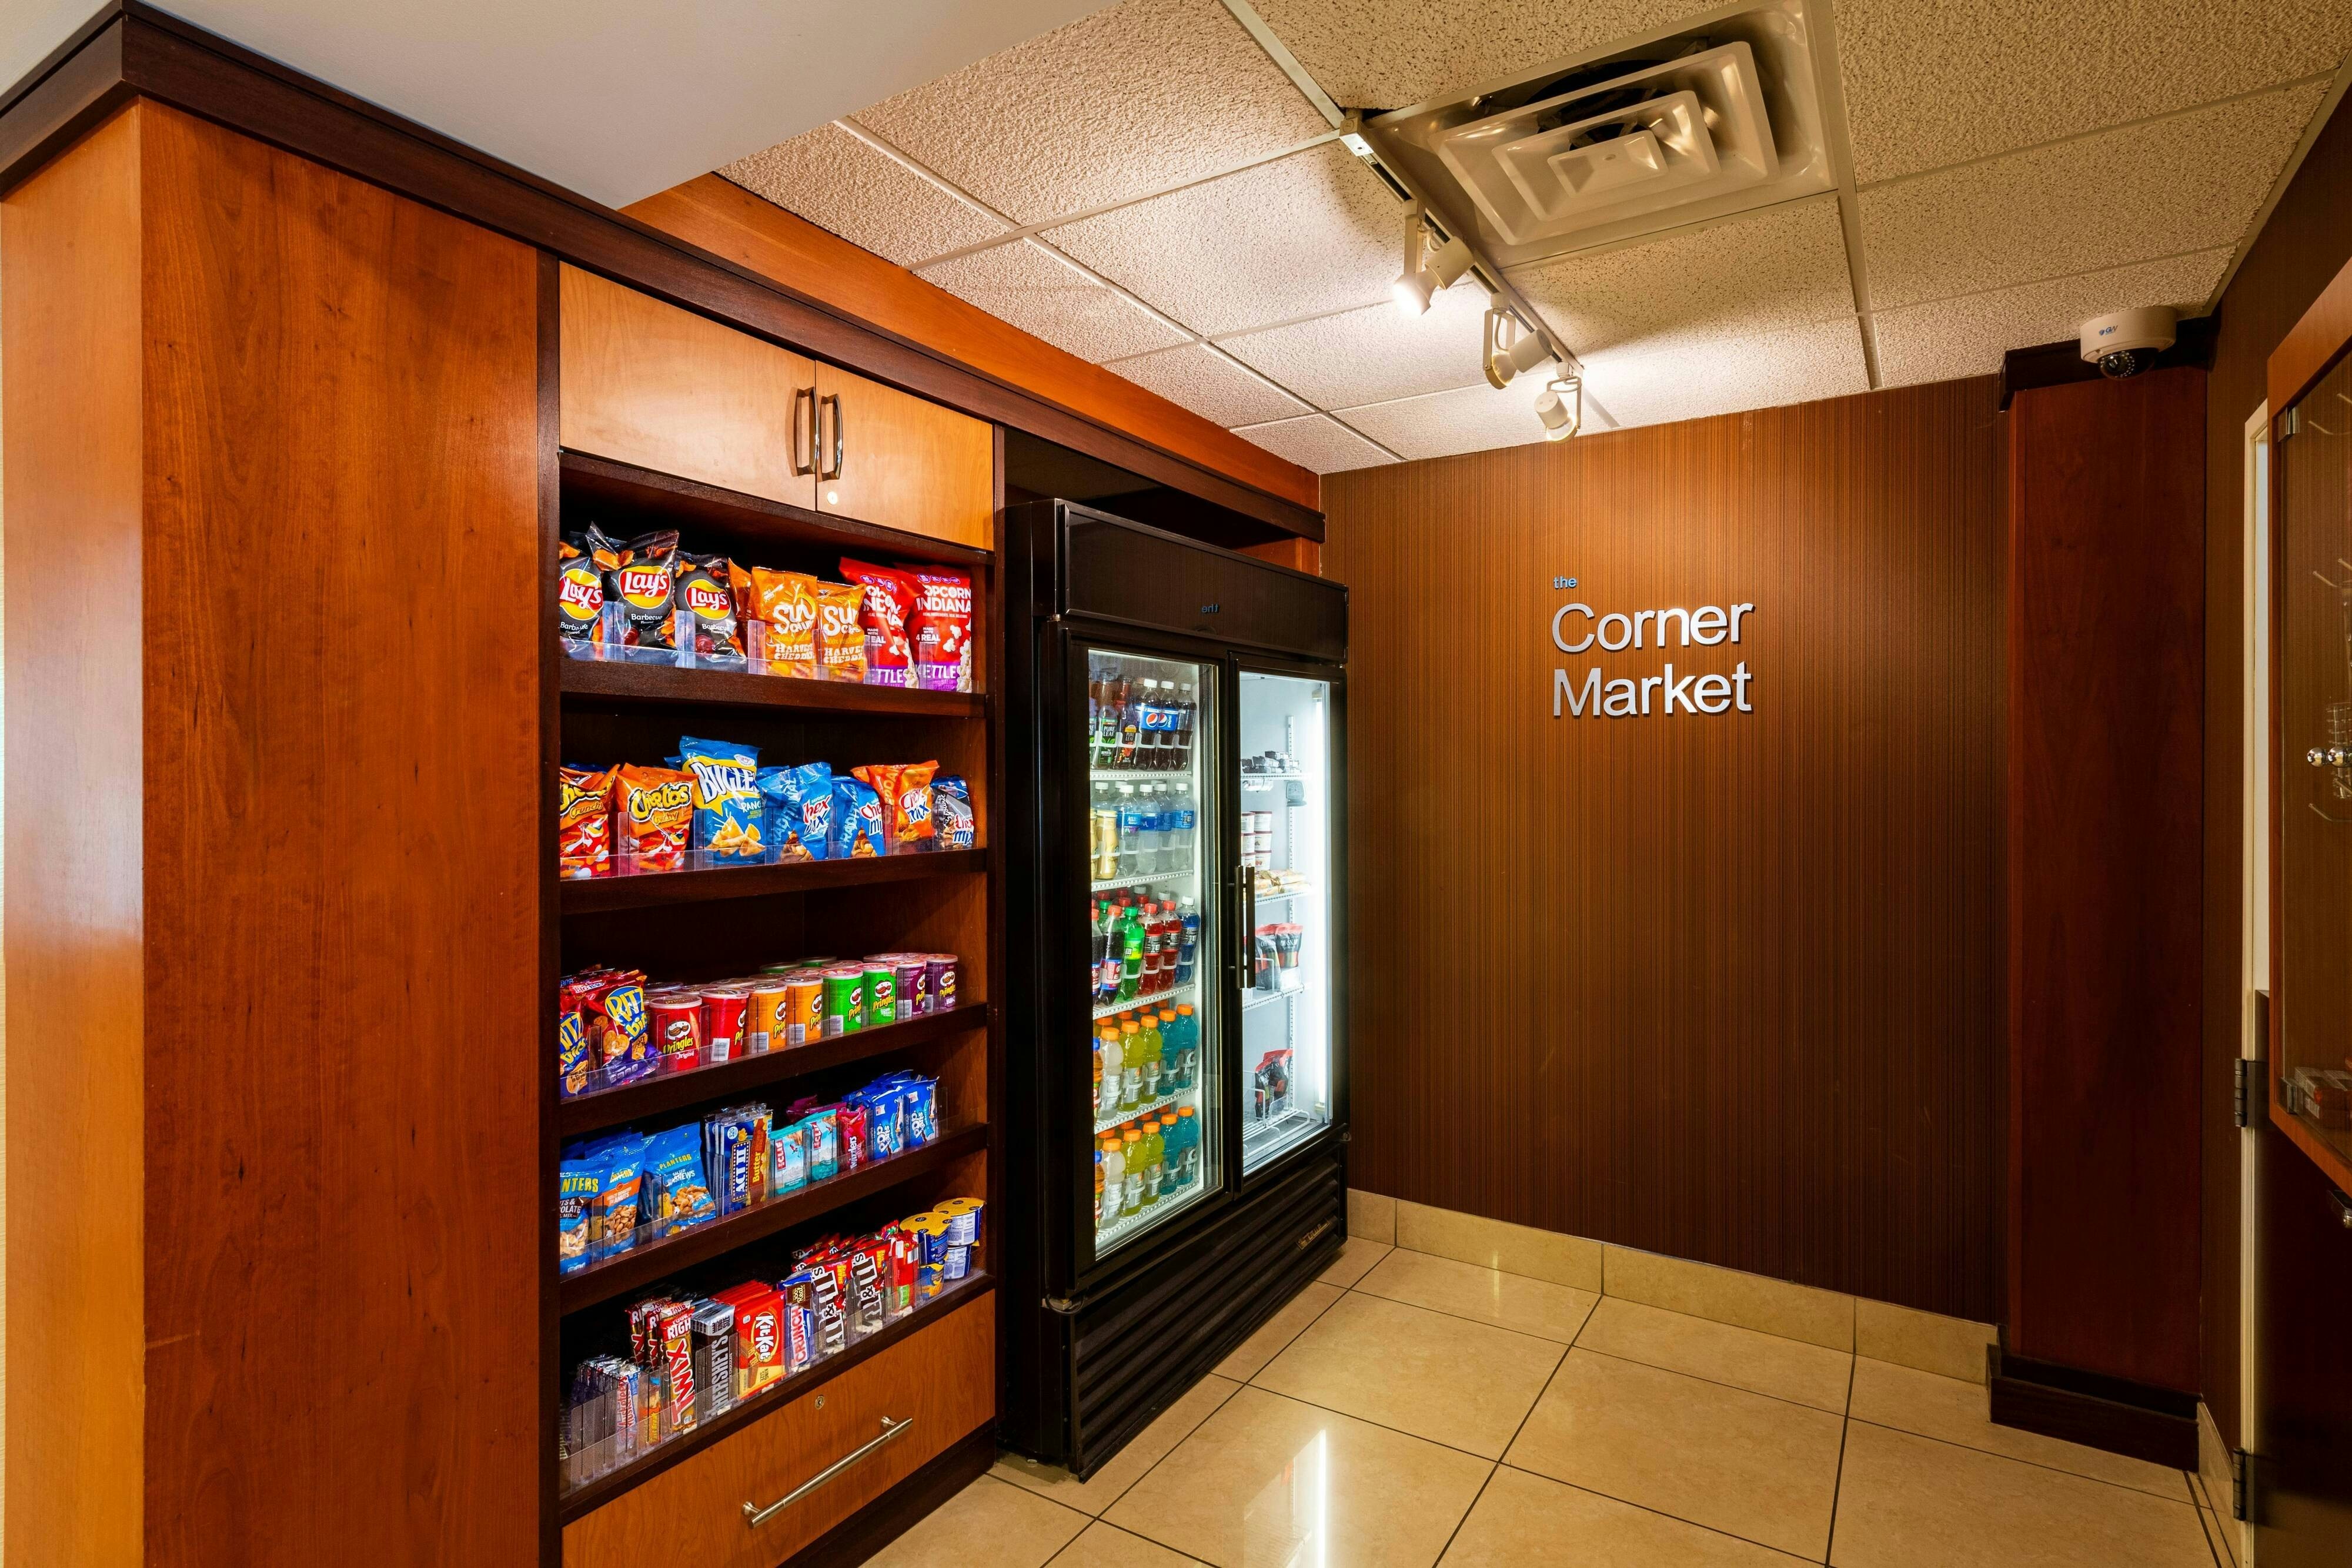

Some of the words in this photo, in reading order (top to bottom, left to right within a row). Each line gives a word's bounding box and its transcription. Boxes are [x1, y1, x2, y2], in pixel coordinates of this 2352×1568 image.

[560, 577, 603, 609] Lay's
[624, 571, 669, 598] Lay's
[1553, 576, 1577, 589] the
[690, 587, 727, 610] Lay's
[916, 597, 971, 613] INDIANA
[1552, 602, 1754, 654] Corner
[1553, 661, 1752, 717] Market
[873, 995, 894, 1012] Pringles
[663, 1035, 693, 1054] Pringles
[659, 1154, 692, 1170] PLANTERS
[736, 1147, 746, 1165] II
[752, 1151, 761, 1183] Butter
[736, 1166, 746, 1192] ACT
[670, 1304, 687, 1314] FOUR
[791, 1307, 808, 1363] CRUNCH
[666, 1338, 696, 1425] TWIX
